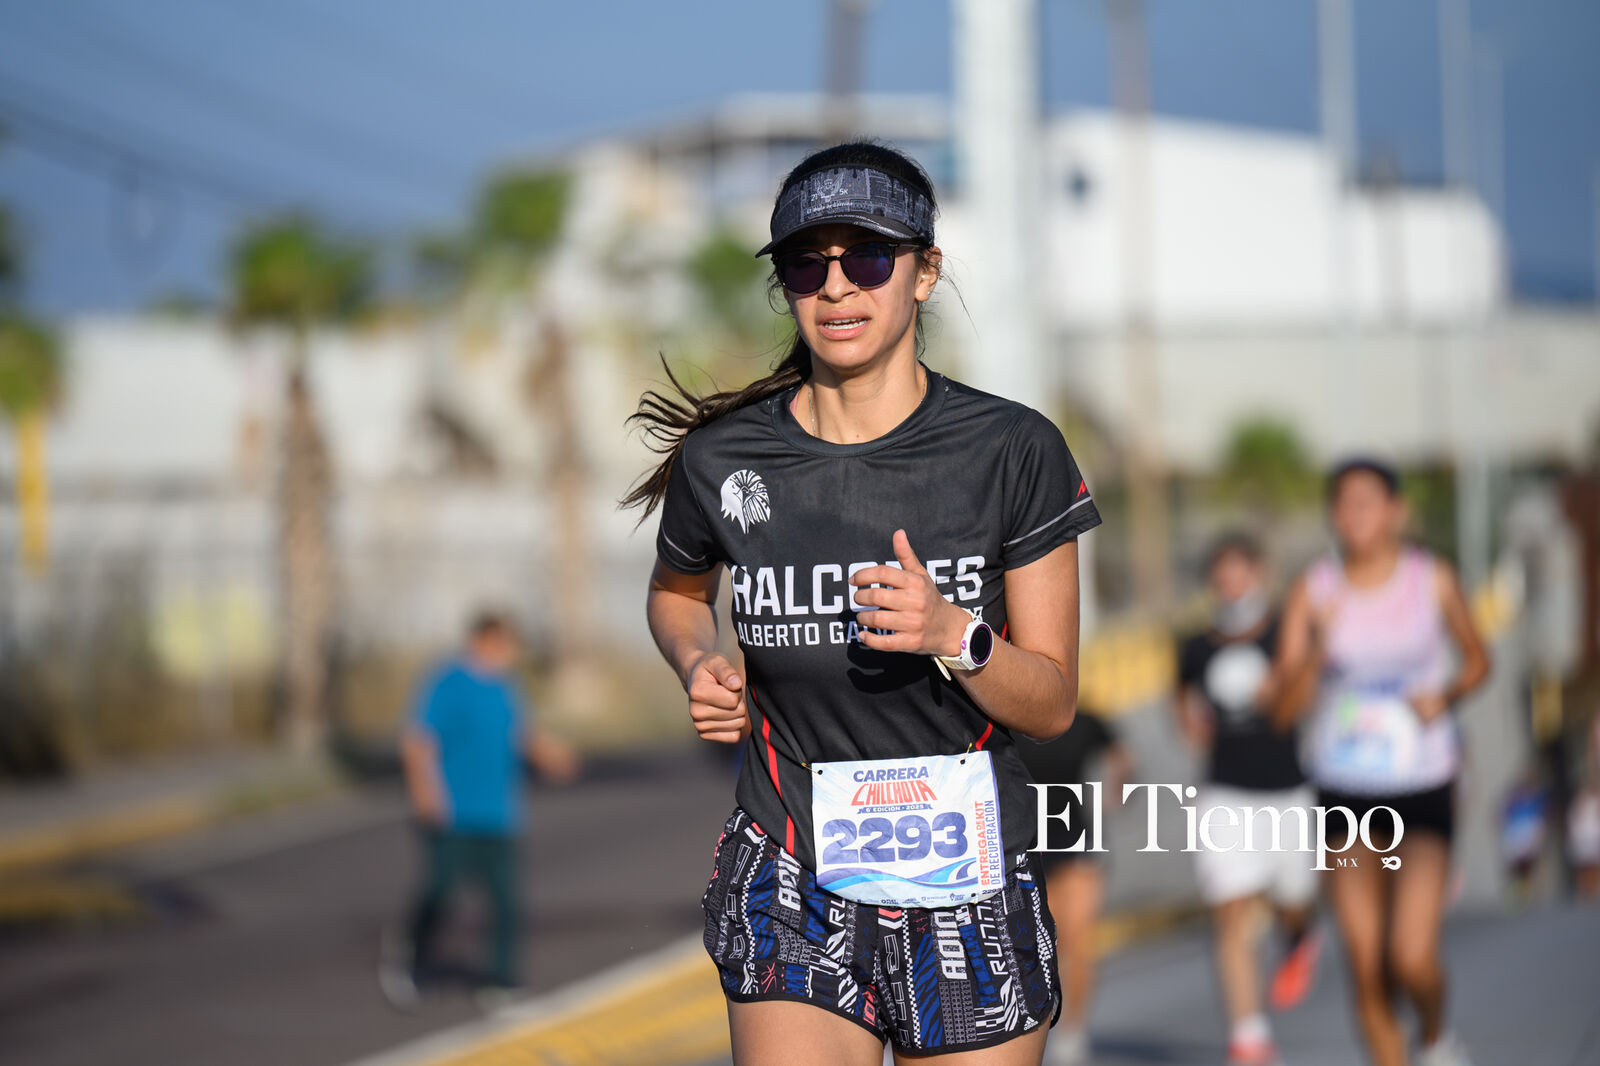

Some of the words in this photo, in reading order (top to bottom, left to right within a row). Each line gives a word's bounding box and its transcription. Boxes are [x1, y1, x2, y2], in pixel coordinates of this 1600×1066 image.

[730, 555, 986, 616] HALCOES
[737, 622, 820, 647] ALBERTO
[853, 766, 929, 783] CARRERA
[850, 779, 938, 806] CHILCHOTA
[974, 801, 985, 820] KIT
[822, 811, 968, 865] 2293
[977, 830, 990, 886] ENTREGA
[989, 872, 1001, 885] DE
